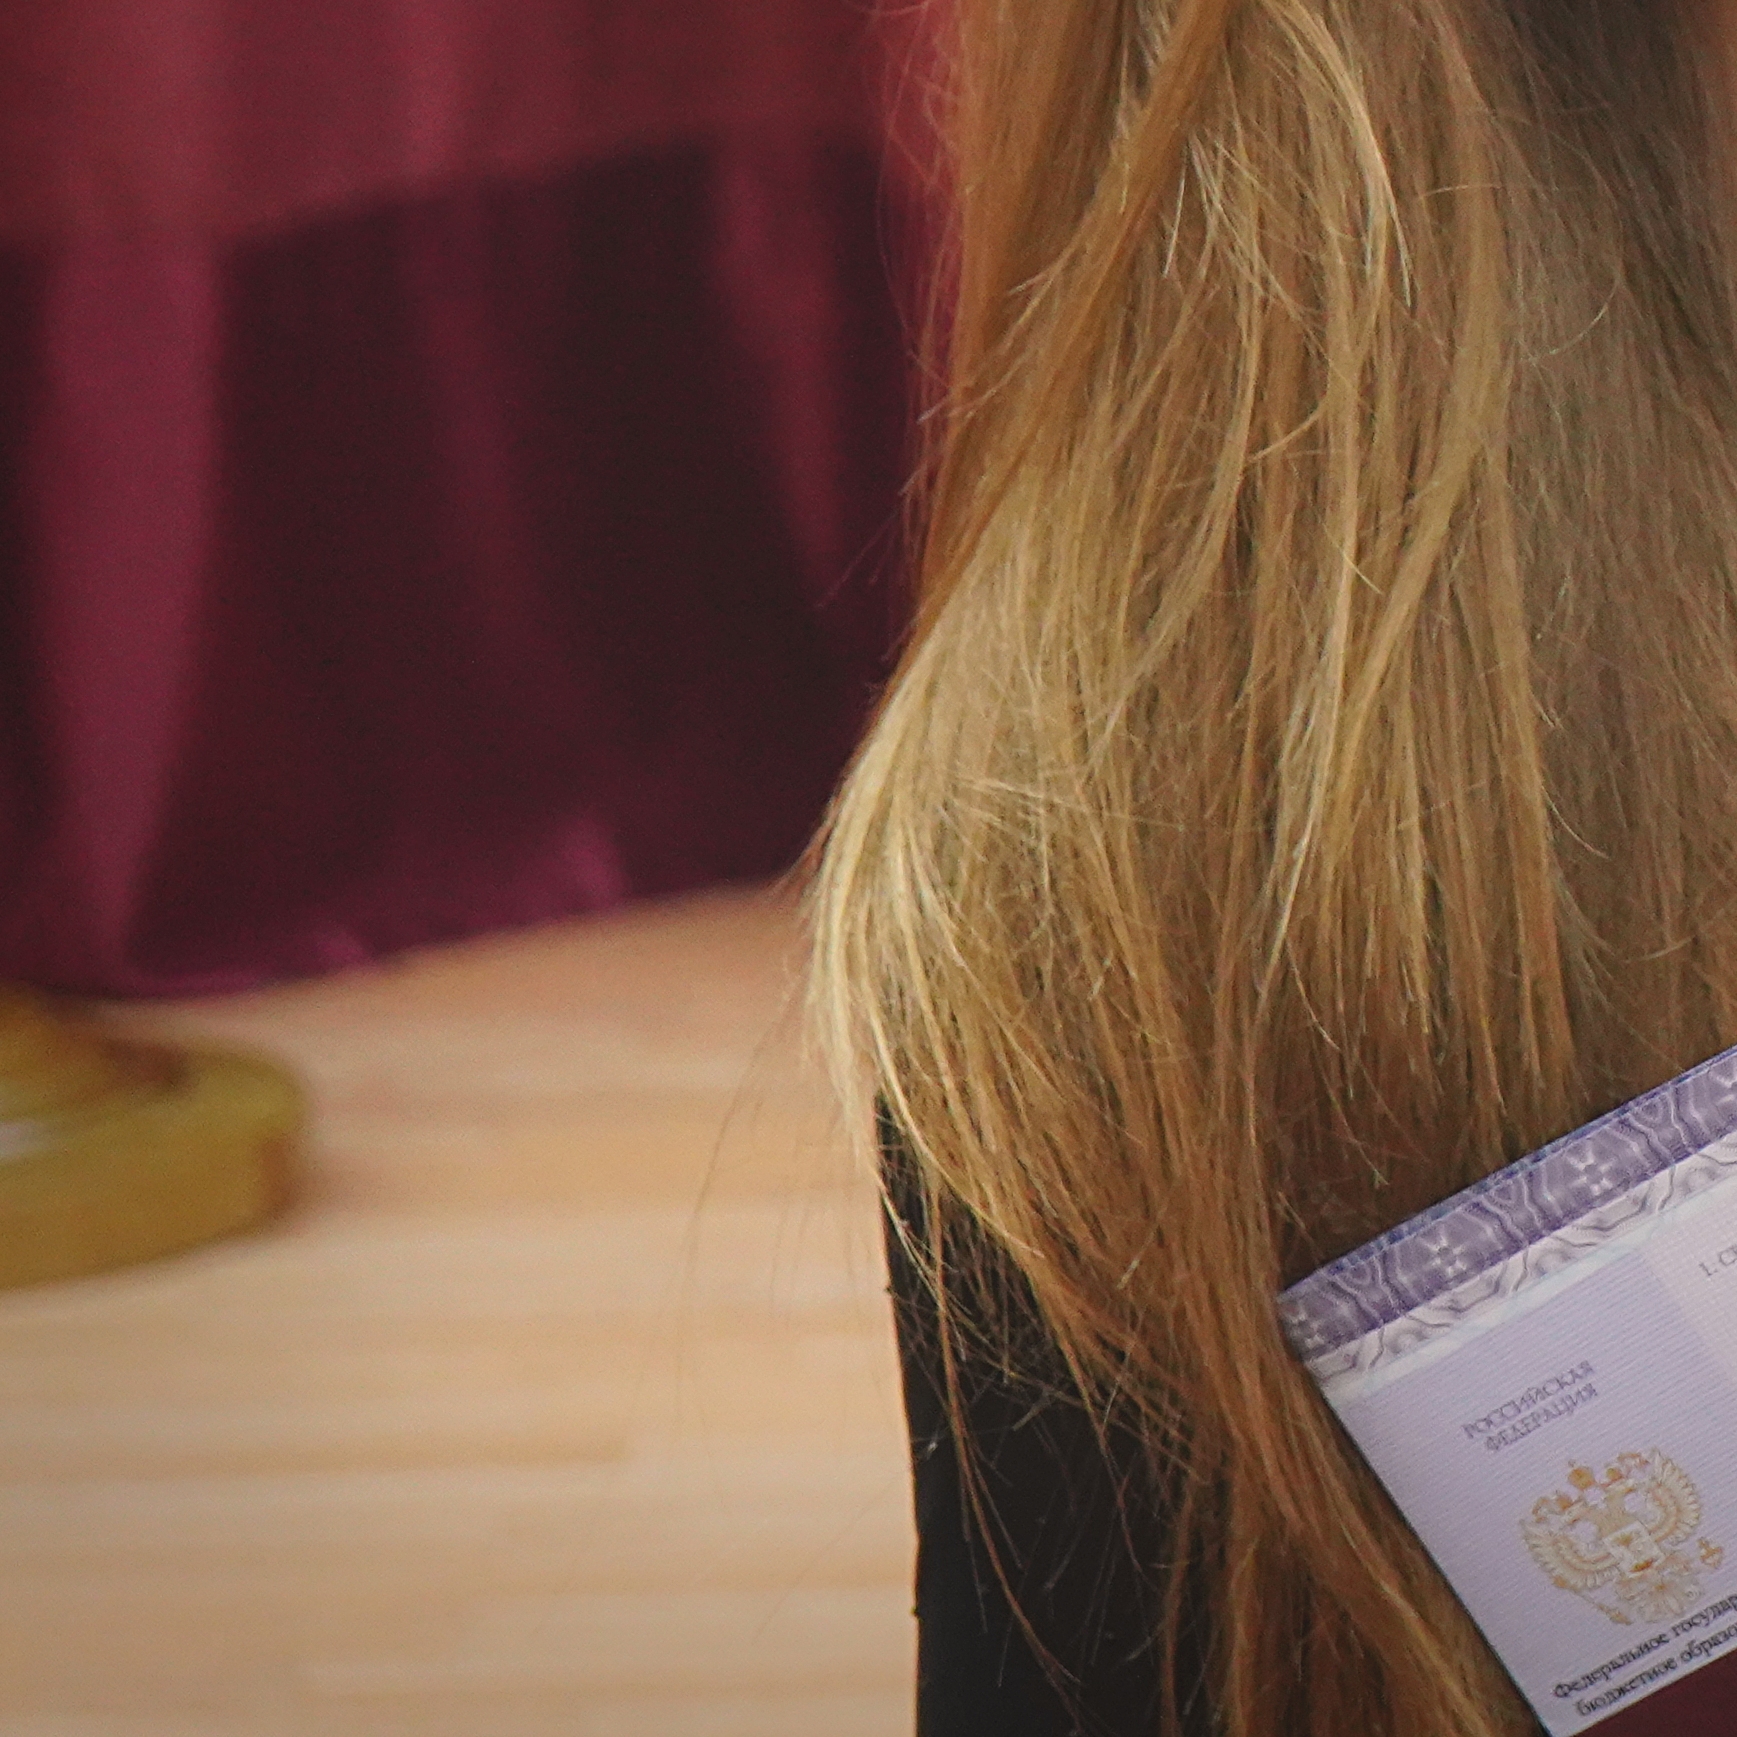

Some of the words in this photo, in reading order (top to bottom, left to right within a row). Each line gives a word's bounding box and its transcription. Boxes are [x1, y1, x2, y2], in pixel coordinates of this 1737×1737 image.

[1698, 1261, 1718, 1277] 1.
[1461, 1359, 1595, 1440] РОССИЙСКАЯ
[1485, 1382, 1598, 1452] ФЕДЕРАЦИЯ
[1553, 1631, 1670, 1698] Федеральное
[1574, 1655, 1678, 1717] бюджетное
